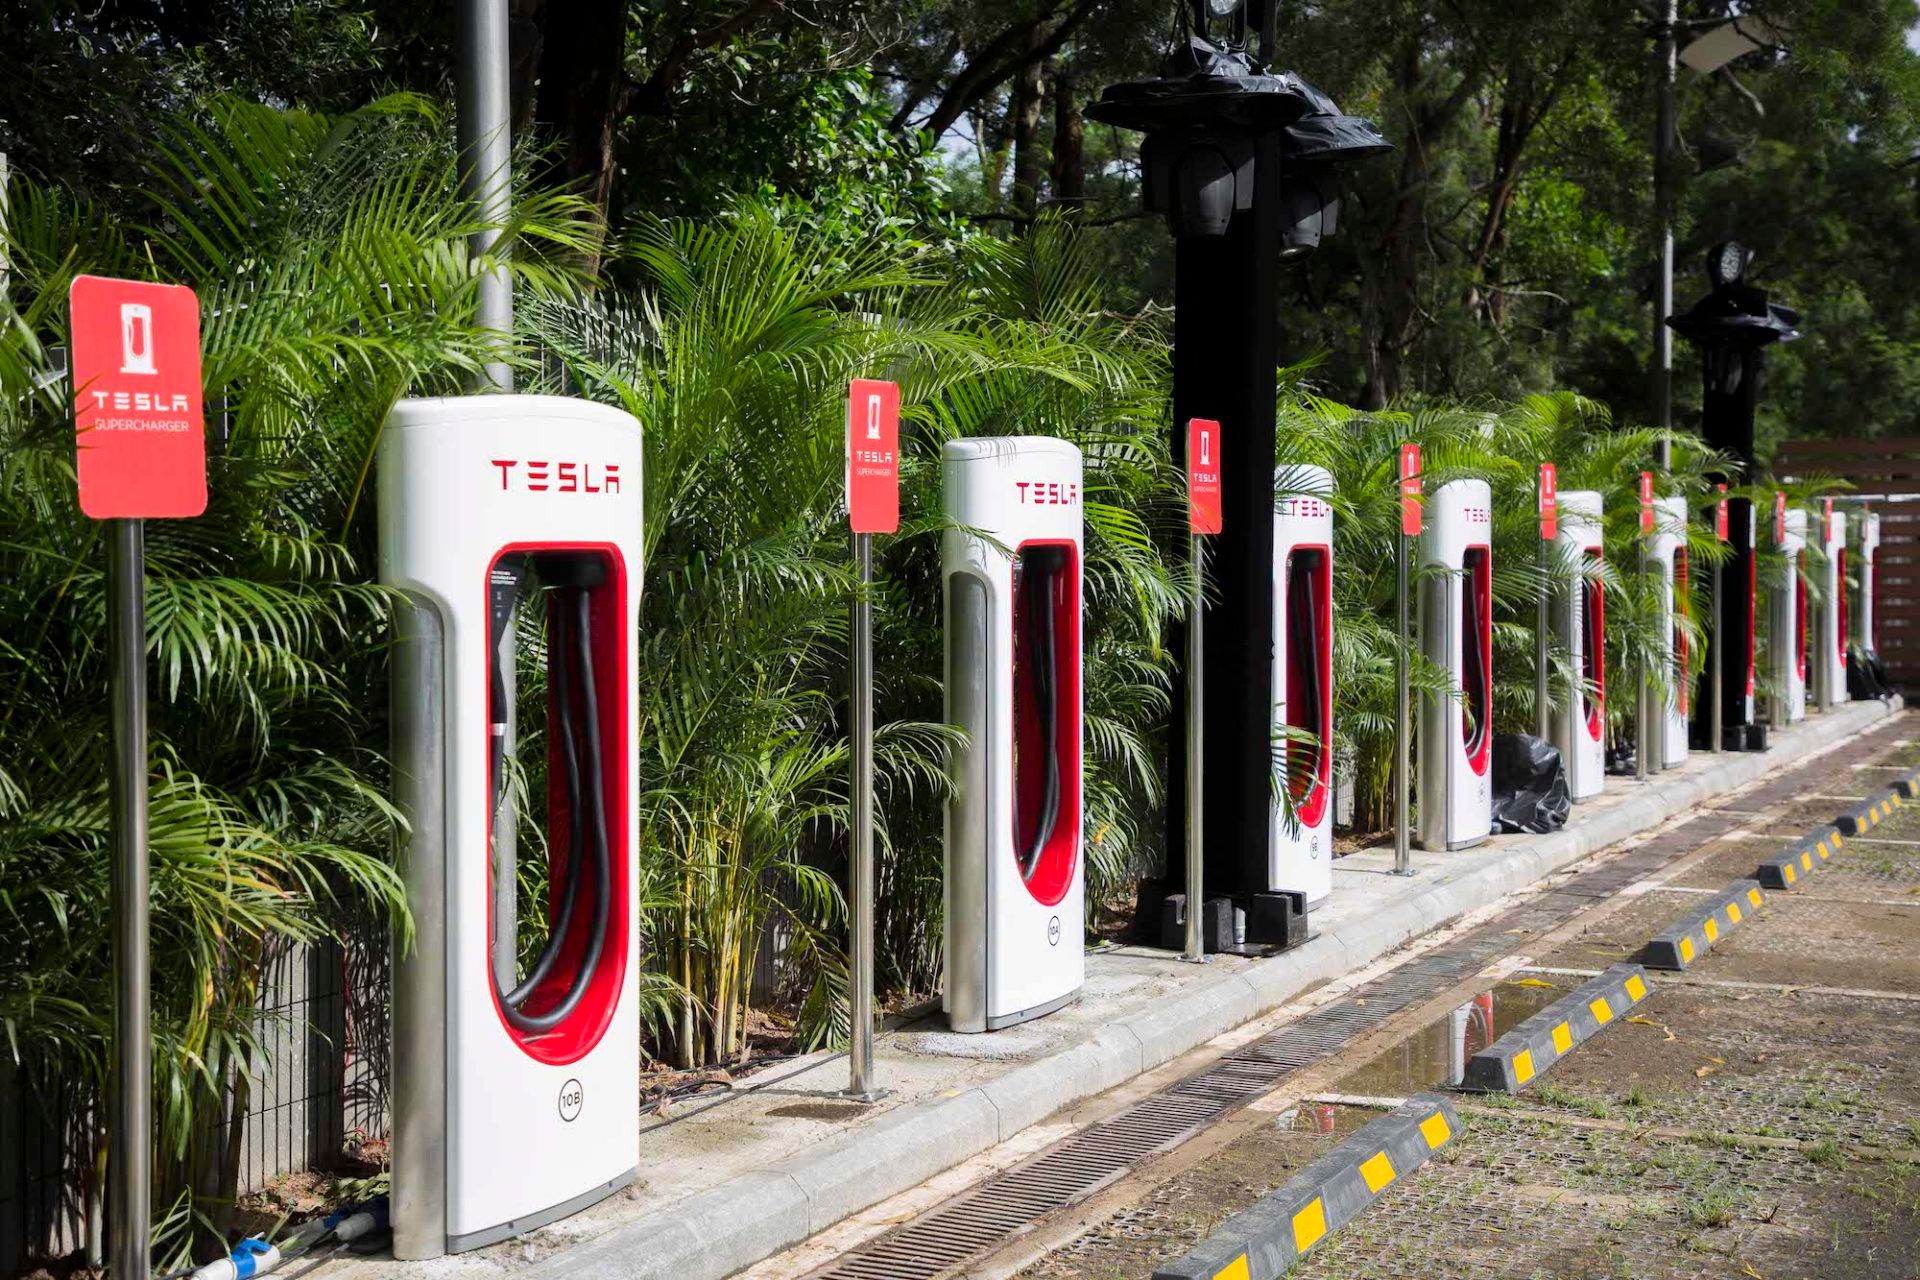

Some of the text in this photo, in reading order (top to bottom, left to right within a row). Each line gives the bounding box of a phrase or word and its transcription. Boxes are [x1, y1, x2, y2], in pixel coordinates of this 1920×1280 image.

[92, 390, 188, 412] TESLA
[95, 418, 190, 432] SUPERCHARGER
[856, 450, 892, 463] TESLA
[491, 460, 620, 493] TESLA
[1193, 472, 1217, 483] TESLA
[1016, 482, 1077, 505] TESLA
[562, 1091, 581, 1108] 10B
